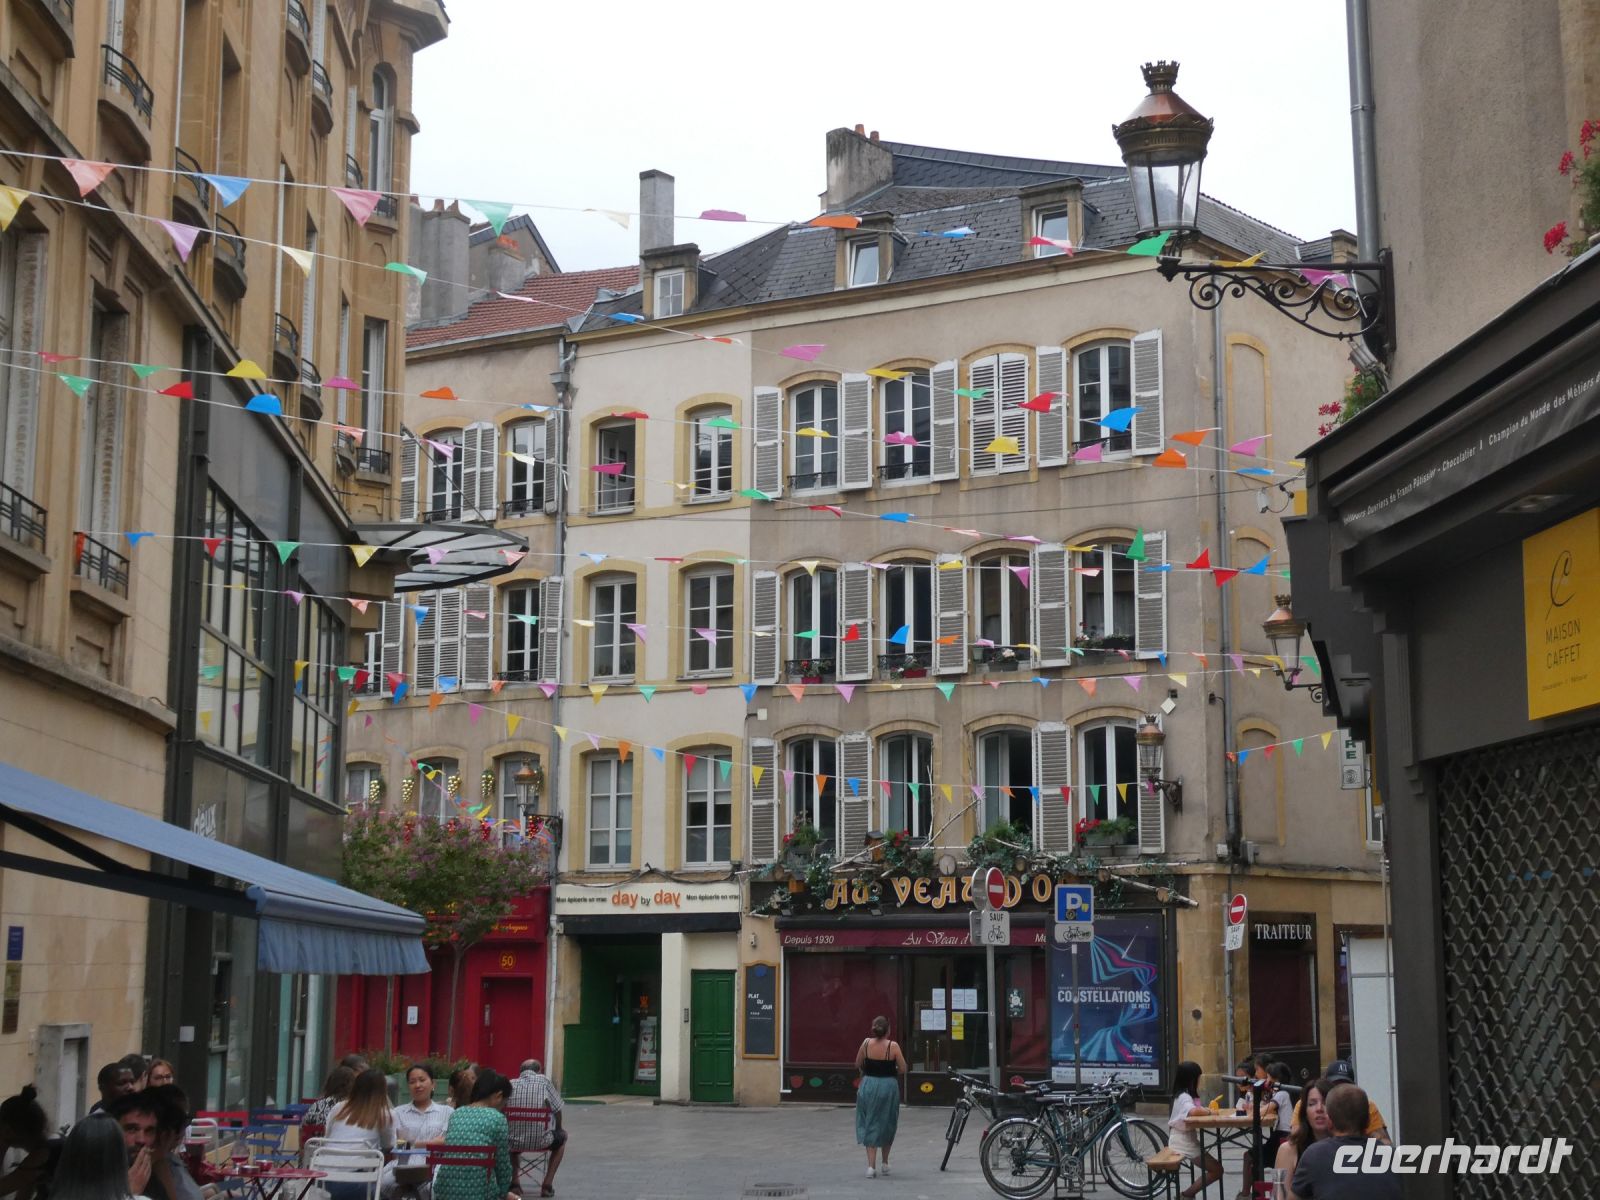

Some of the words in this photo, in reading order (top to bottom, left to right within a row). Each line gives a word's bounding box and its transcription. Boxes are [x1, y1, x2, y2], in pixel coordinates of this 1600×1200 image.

[1367, 498, 1389, 515] Ouvriers
[1442, 446, 1476, 471] Chocolatier
[1488, 422, 1519, 445] Champion
[1521, 416, 1528, 427] du
[1530, 402, 1550, 421] Monde
[1553, 394, 1566, 409] des
[1545, 618, 1581, 645] MAISON
[1546, 644, 1581, 669] CAFFET
[612, 890, 638, 909] day
[641, 896, 650, 907] by
[654, 889, 681, 908] day
[824, 877, 869, 910] AU
[1066, 893, 1082, 910] P
[990, 912, 1004, 921] SAUF
[784, 935, 812, 945] Depuis
[815, 935, 835, 944] 1930
[902, 932, 922, 945] Au
[926, 931, 958, 945] Veau
[1255, 923, 1313, 940] TRAITEUR
[501, 955, 514, 967] 50
